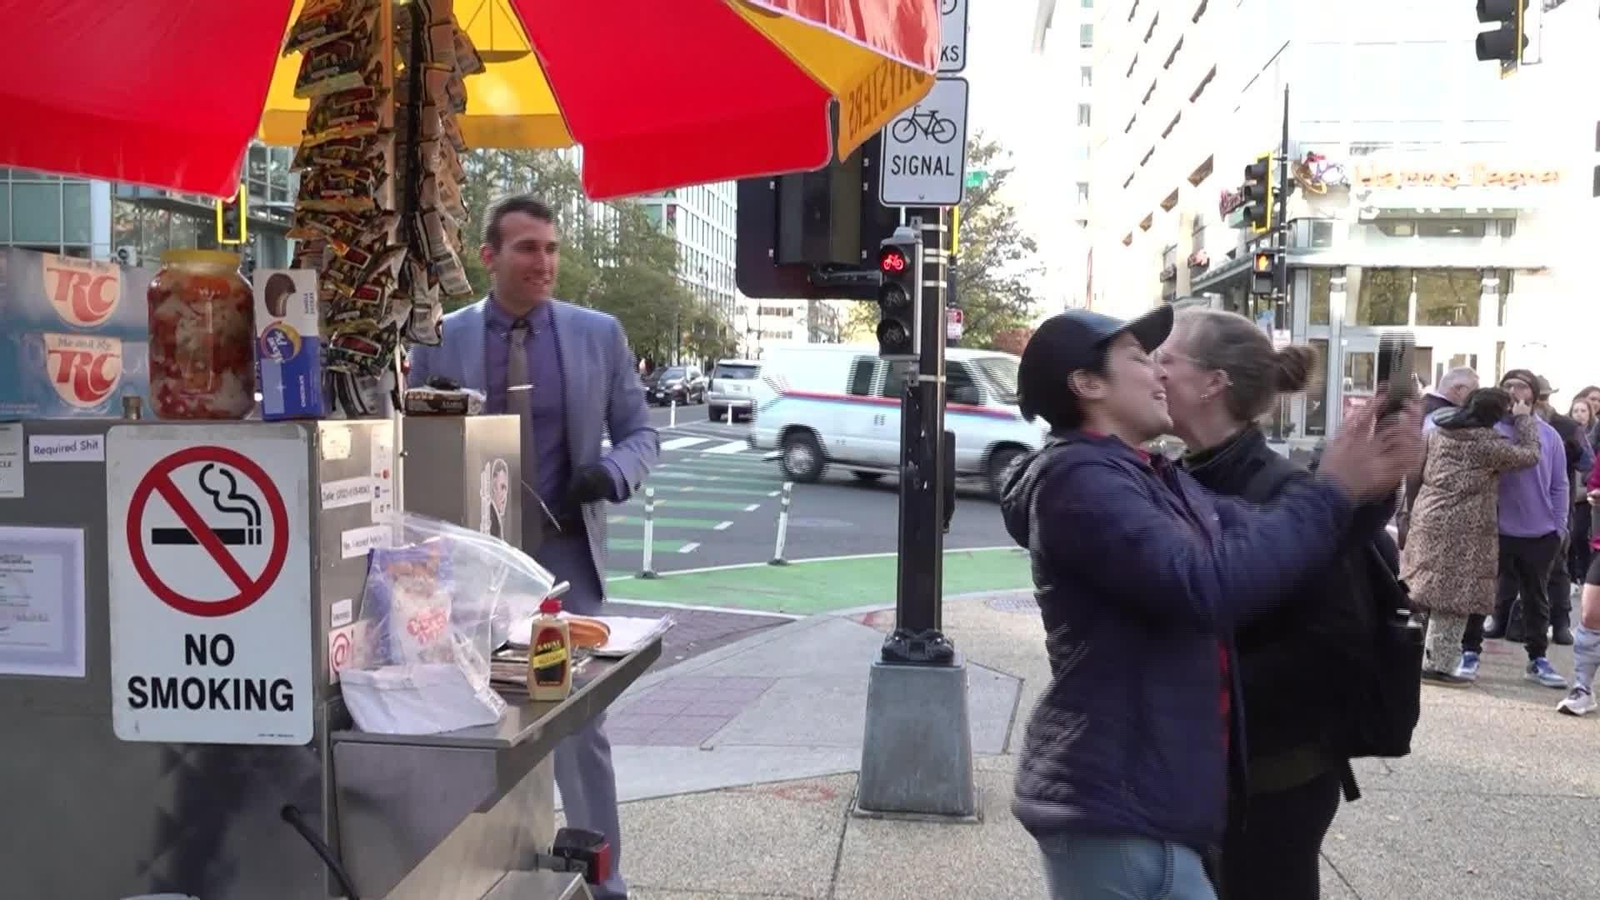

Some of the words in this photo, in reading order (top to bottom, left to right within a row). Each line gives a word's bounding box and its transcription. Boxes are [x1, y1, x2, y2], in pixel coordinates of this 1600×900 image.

[891, 155, 955, 176] SIGNAL
[46, 267, 117, 322] RC
[48, 350, 120, 402] RC
[33, 440, 77, 456] Required
[80, 439, 99, 451] Shit
[184, 633, 236, 667] NO
[127, 675, 294, 712] SMOKING
